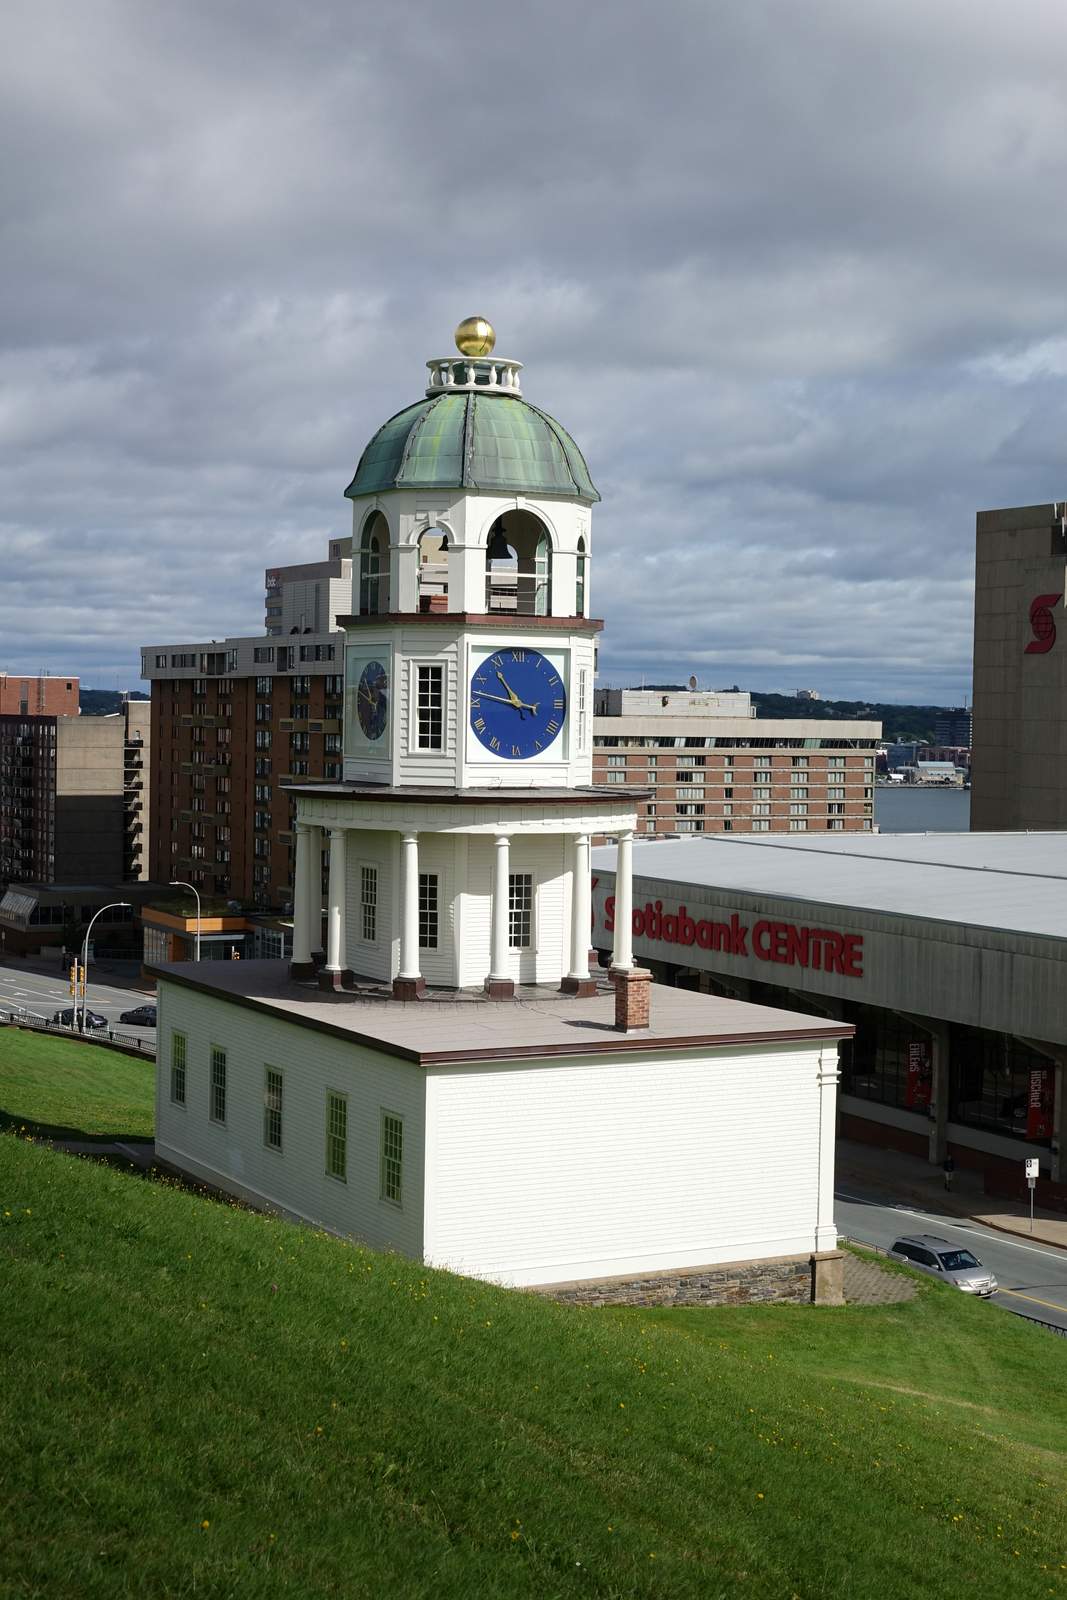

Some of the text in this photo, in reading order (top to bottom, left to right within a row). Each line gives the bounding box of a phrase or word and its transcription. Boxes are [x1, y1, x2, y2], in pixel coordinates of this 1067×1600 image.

[511, 650, 525, 662] XII
[491, 655, 504, 669] XI
[536, 658, 542, 668] I
[476, 674, 488, 685] X
[549, 675, 559, 686] II
[553, 699, 564, 709] III
[604, 895, 864, 977] Sotiabank CENTRE
